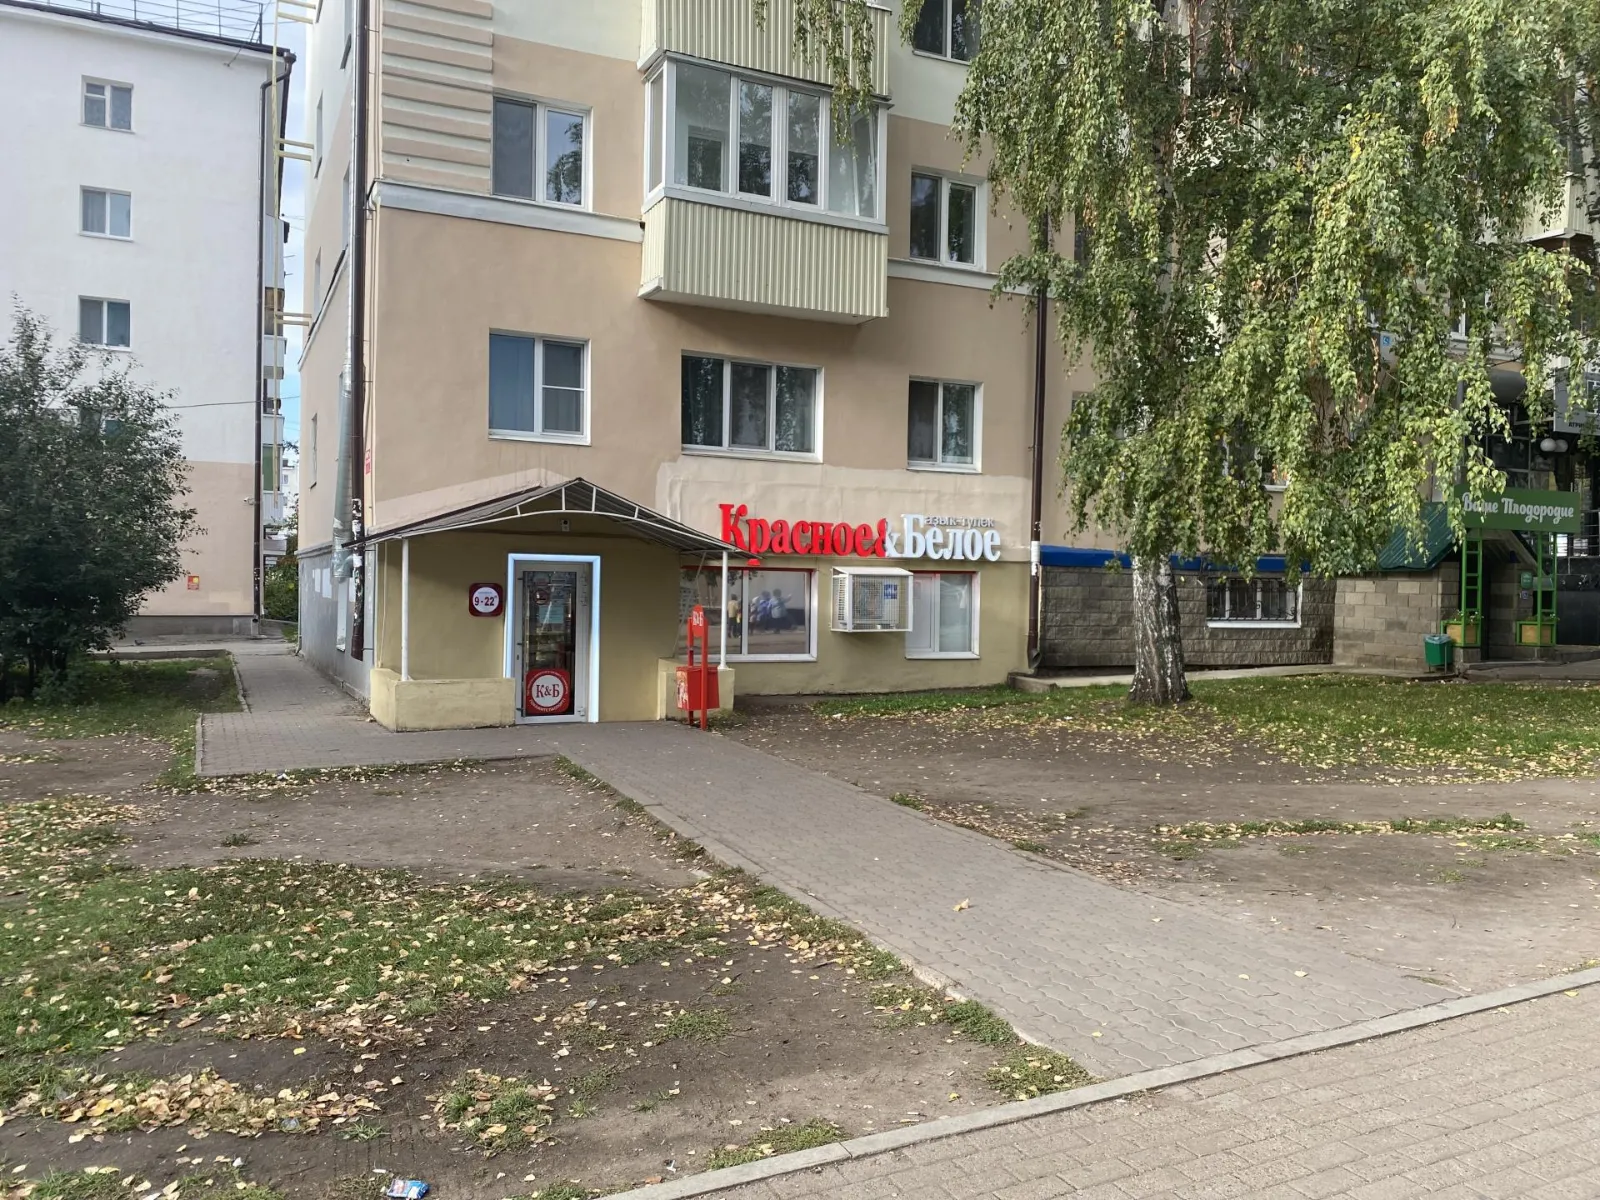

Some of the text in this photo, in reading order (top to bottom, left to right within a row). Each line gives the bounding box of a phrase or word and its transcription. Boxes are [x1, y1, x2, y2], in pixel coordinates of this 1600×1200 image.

[1462, 492, 1575, 524] Ваше Плодородие
[536, 683, 560, 698] К&Б
